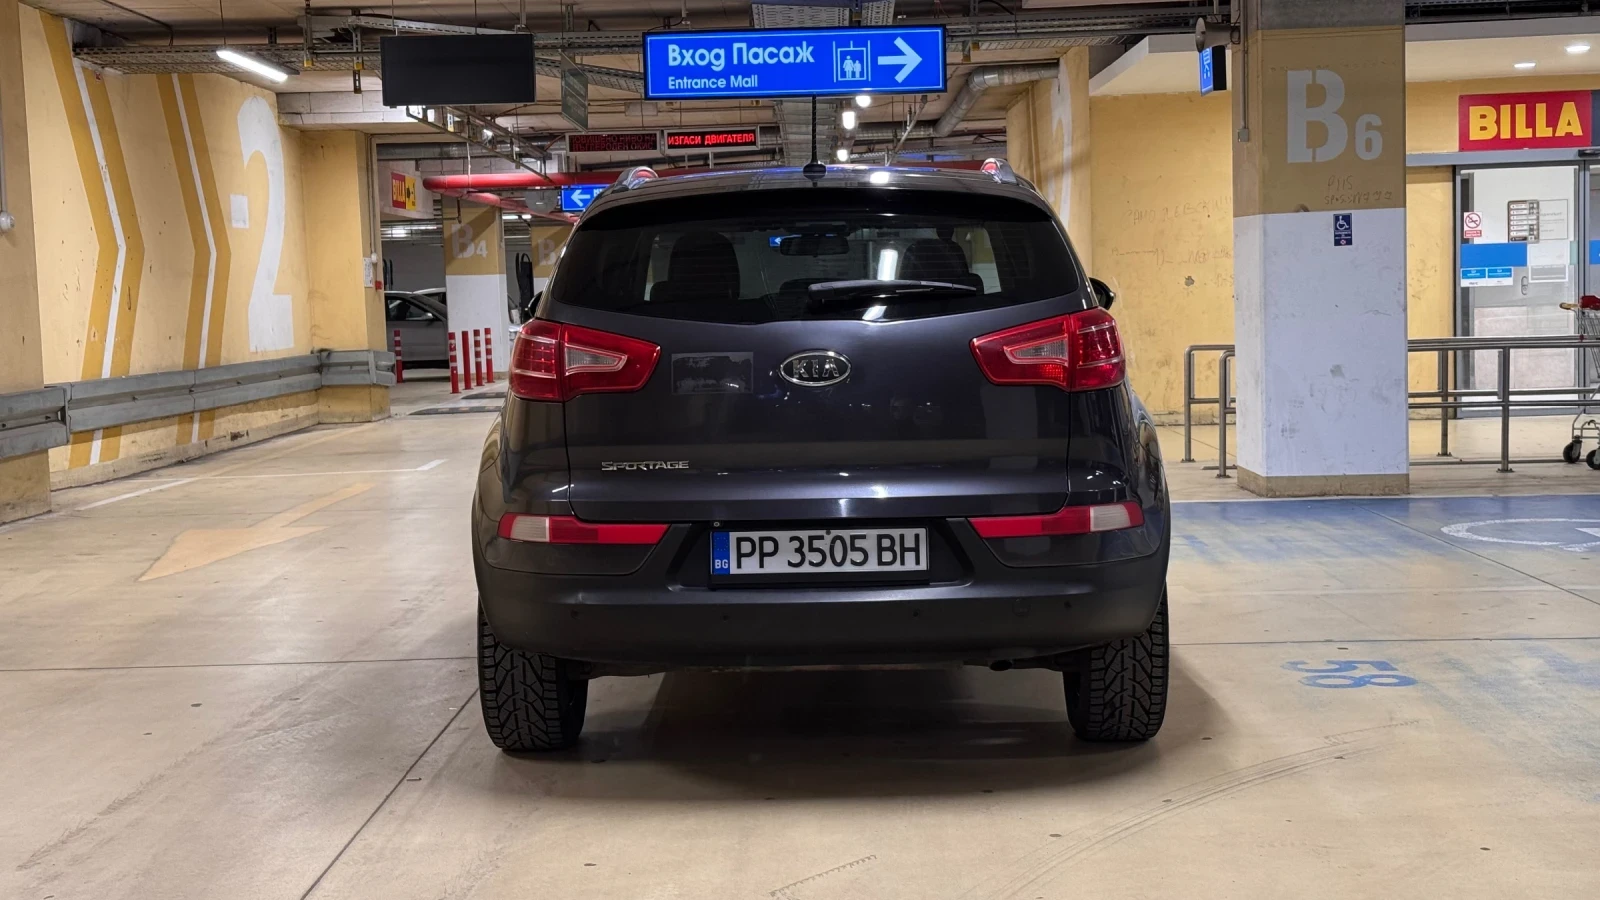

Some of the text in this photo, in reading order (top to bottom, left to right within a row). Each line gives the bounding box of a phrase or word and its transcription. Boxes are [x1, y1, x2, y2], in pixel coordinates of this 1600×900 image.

[667, 40, 815, 71] Вход Пасаж
[667, 74, 758, 90] Entrance Mall
[1468, 101, 1584, 141] BILLA
[667, 132, 755, 146] ИЗГАСИ ДВИГАТЕЛЯ
[791, 357, 840, 379] KIA
[601, 460, 690, 472] SPORTAGE
[714, 532, 921, 569] BG PP 3505 BH
[1281, 659, 1418, 689] 58
